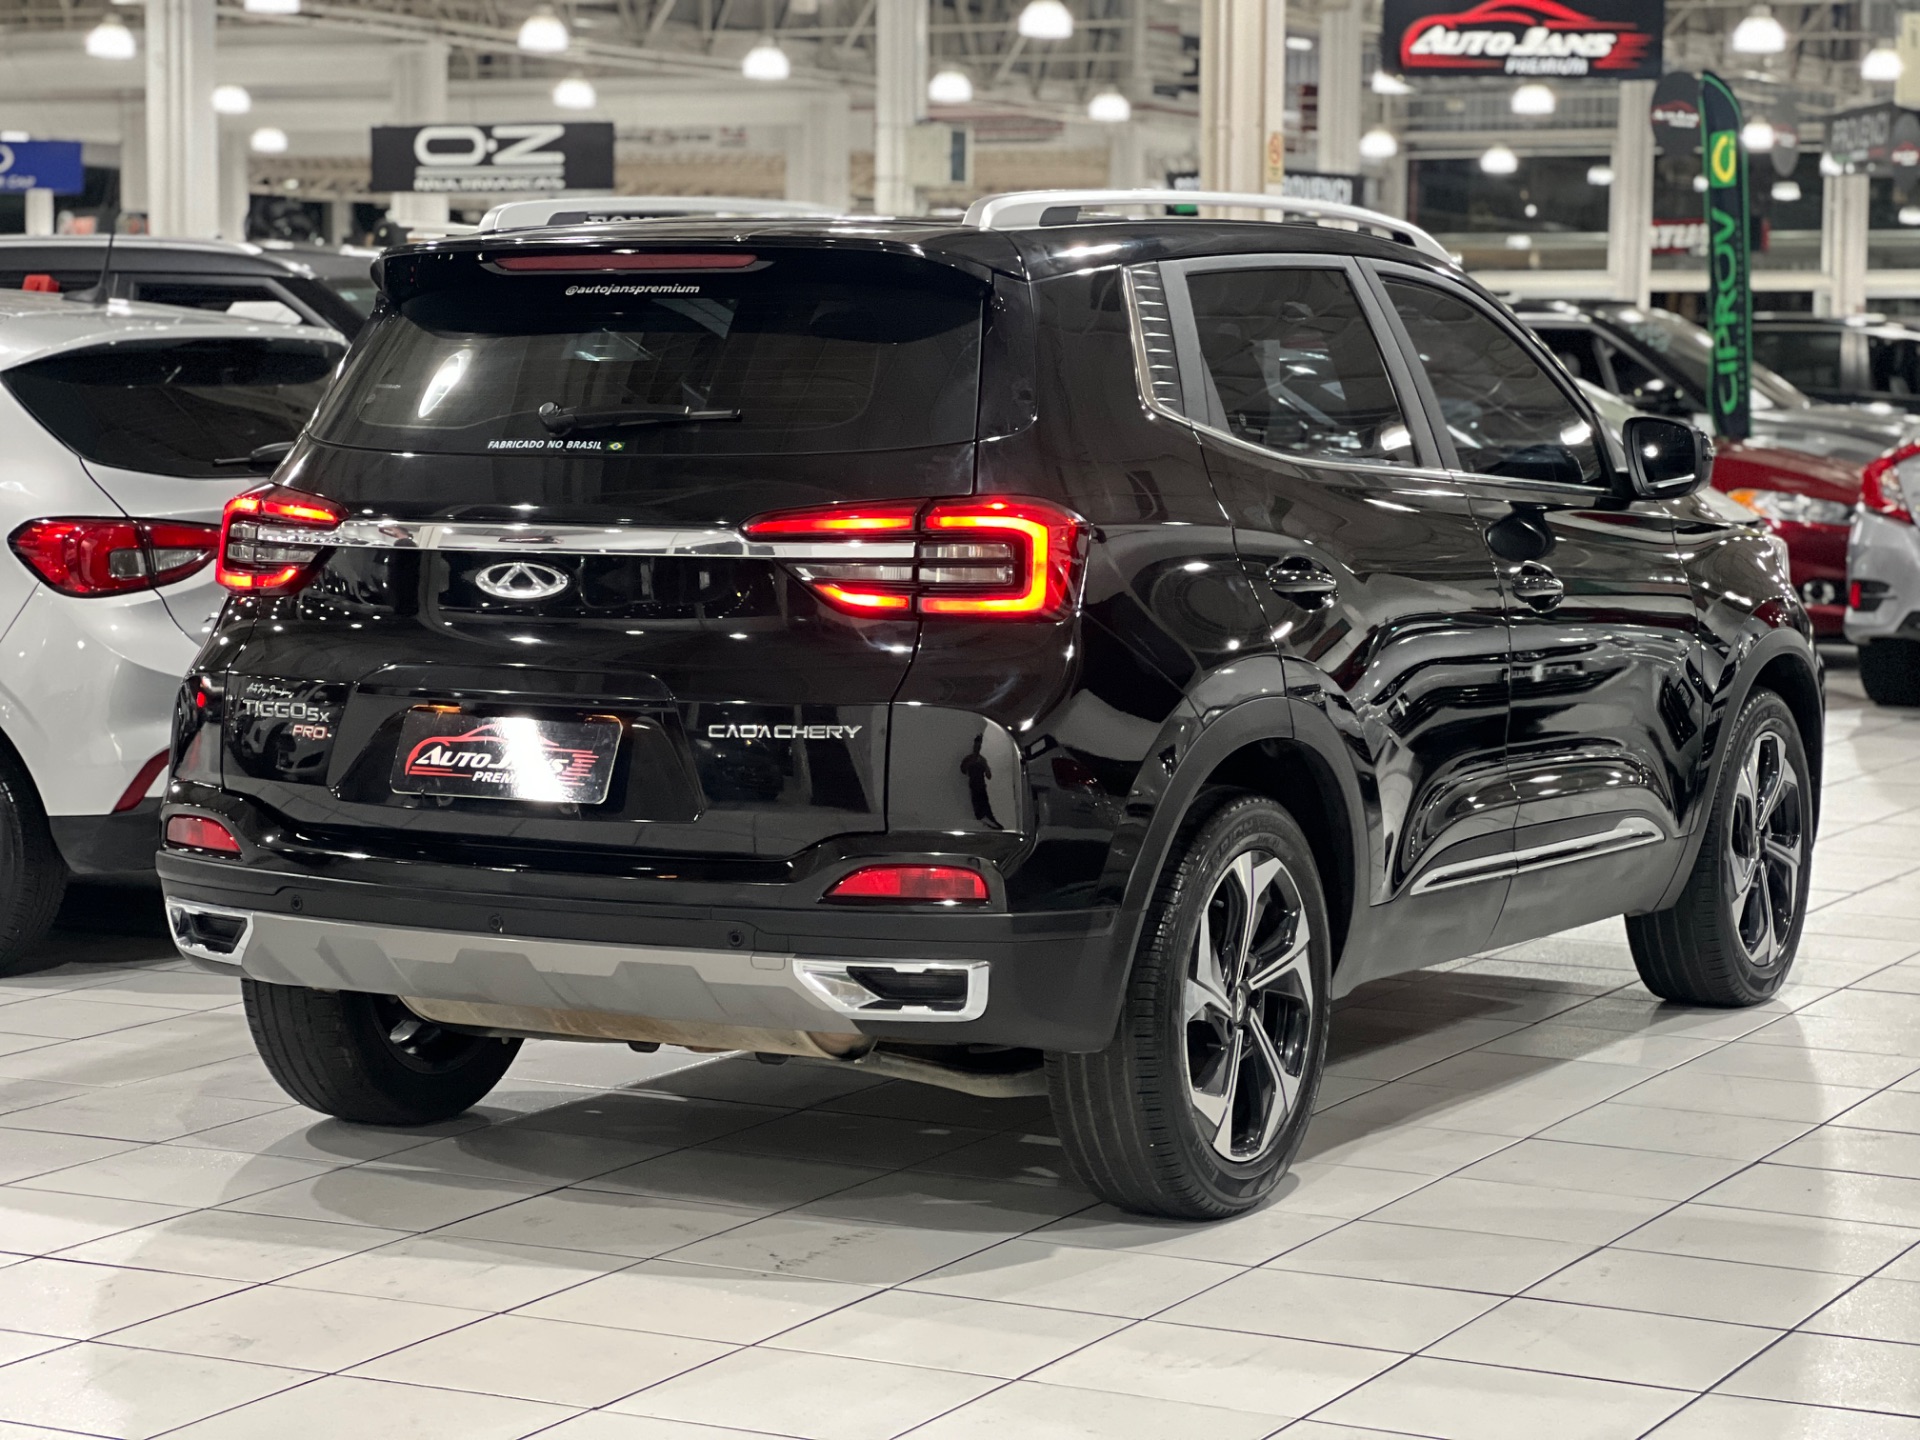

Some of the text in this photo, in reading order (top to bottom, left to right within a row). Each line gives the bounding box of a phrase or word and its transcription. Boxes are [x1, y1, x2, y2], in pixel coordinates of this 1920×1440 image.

[565, 283, 700, 296] @autojanspremium
[1711, 207, 1738, 415] CIPROV
[487, 440, 602, 450] FABRICADO NO BRASIL
[292, 724, 328, 739] PRO
[773, 725, 863, 739] CHERY
[415, 745, 492, 769] AUTO
